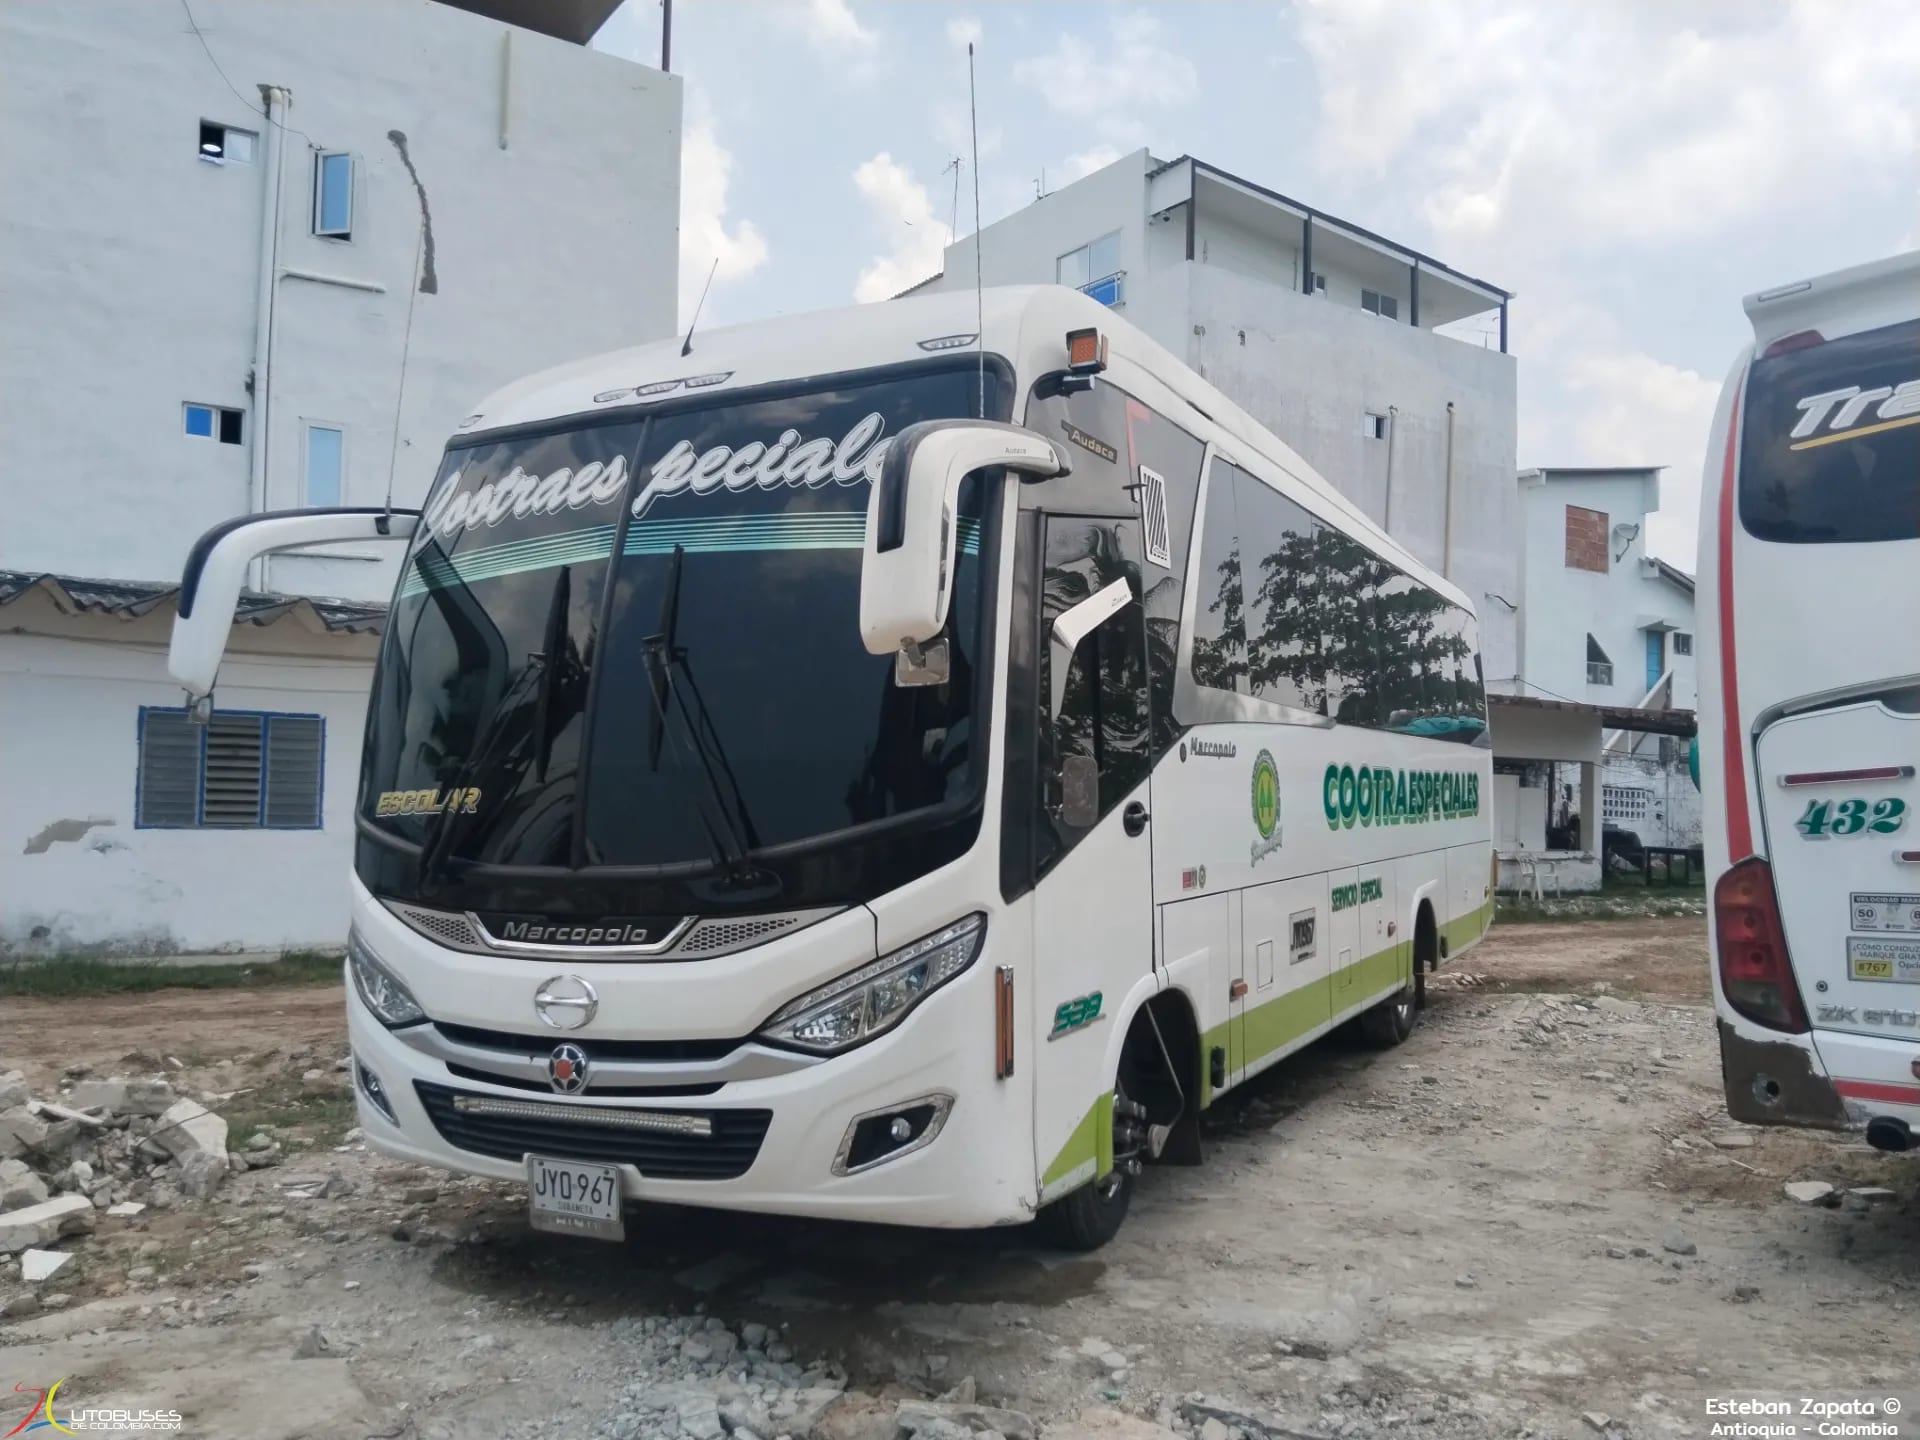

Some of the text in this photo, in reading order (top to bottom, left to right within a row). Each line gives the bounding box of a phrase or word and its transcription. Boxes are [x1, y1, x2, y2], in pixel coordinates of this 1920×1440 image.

[1072, 429, 1115, 460] Audace
[1190, 737, 1237, 759] Marcopolo
[376, 787, 482, 817] ESCOLAR
[1323, 762, 1479, 830] COOTRAESPECIALES
[1796, 798, 1907, 837] 432
[1858, 909, 1874, 918] 50
[503, 921, 648, 944] Marcopolo
